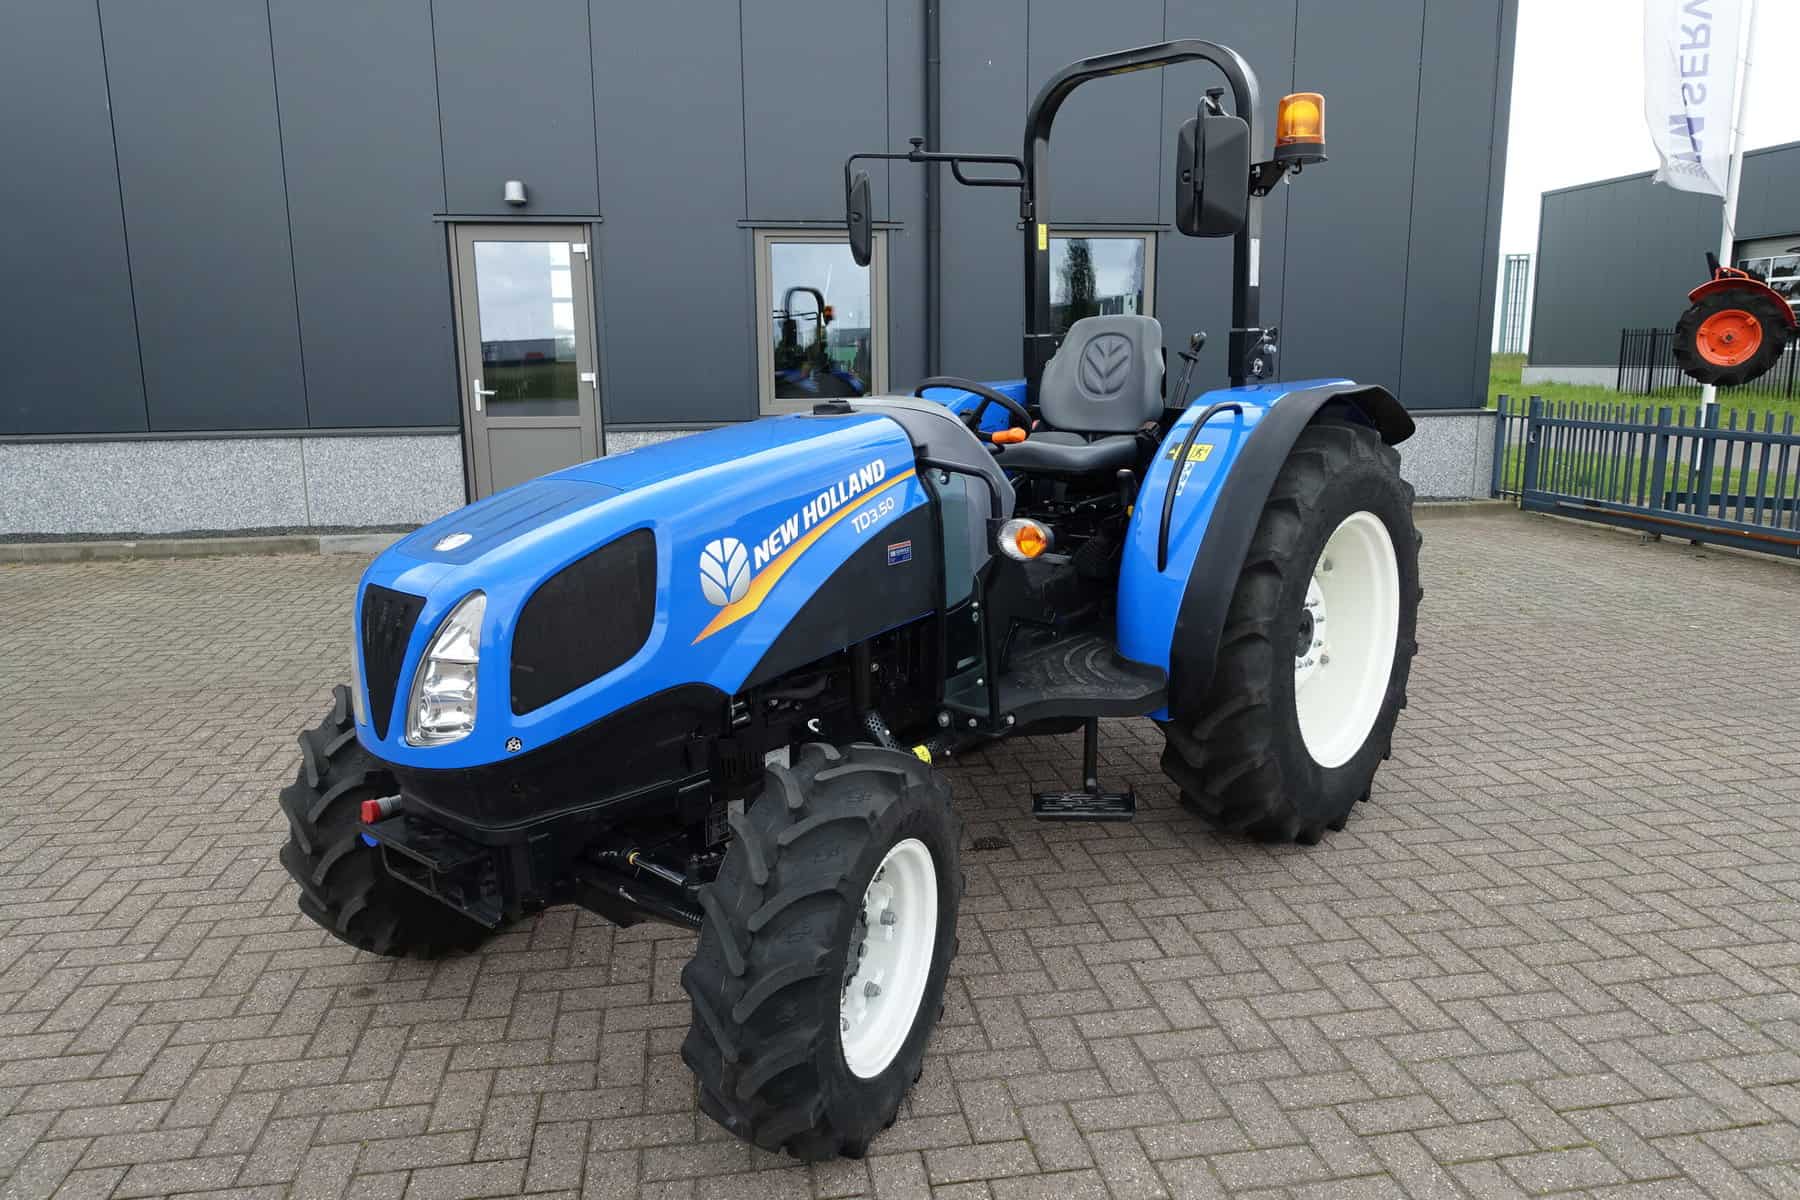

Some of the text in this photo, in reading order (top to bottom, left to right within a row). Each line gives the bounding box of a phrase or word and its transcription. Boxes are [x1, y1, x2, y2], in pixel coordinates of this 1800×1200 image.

[753, 458, 886, 570] NEW HOLLAND
[851, 496, 895, 534] TD3.50
